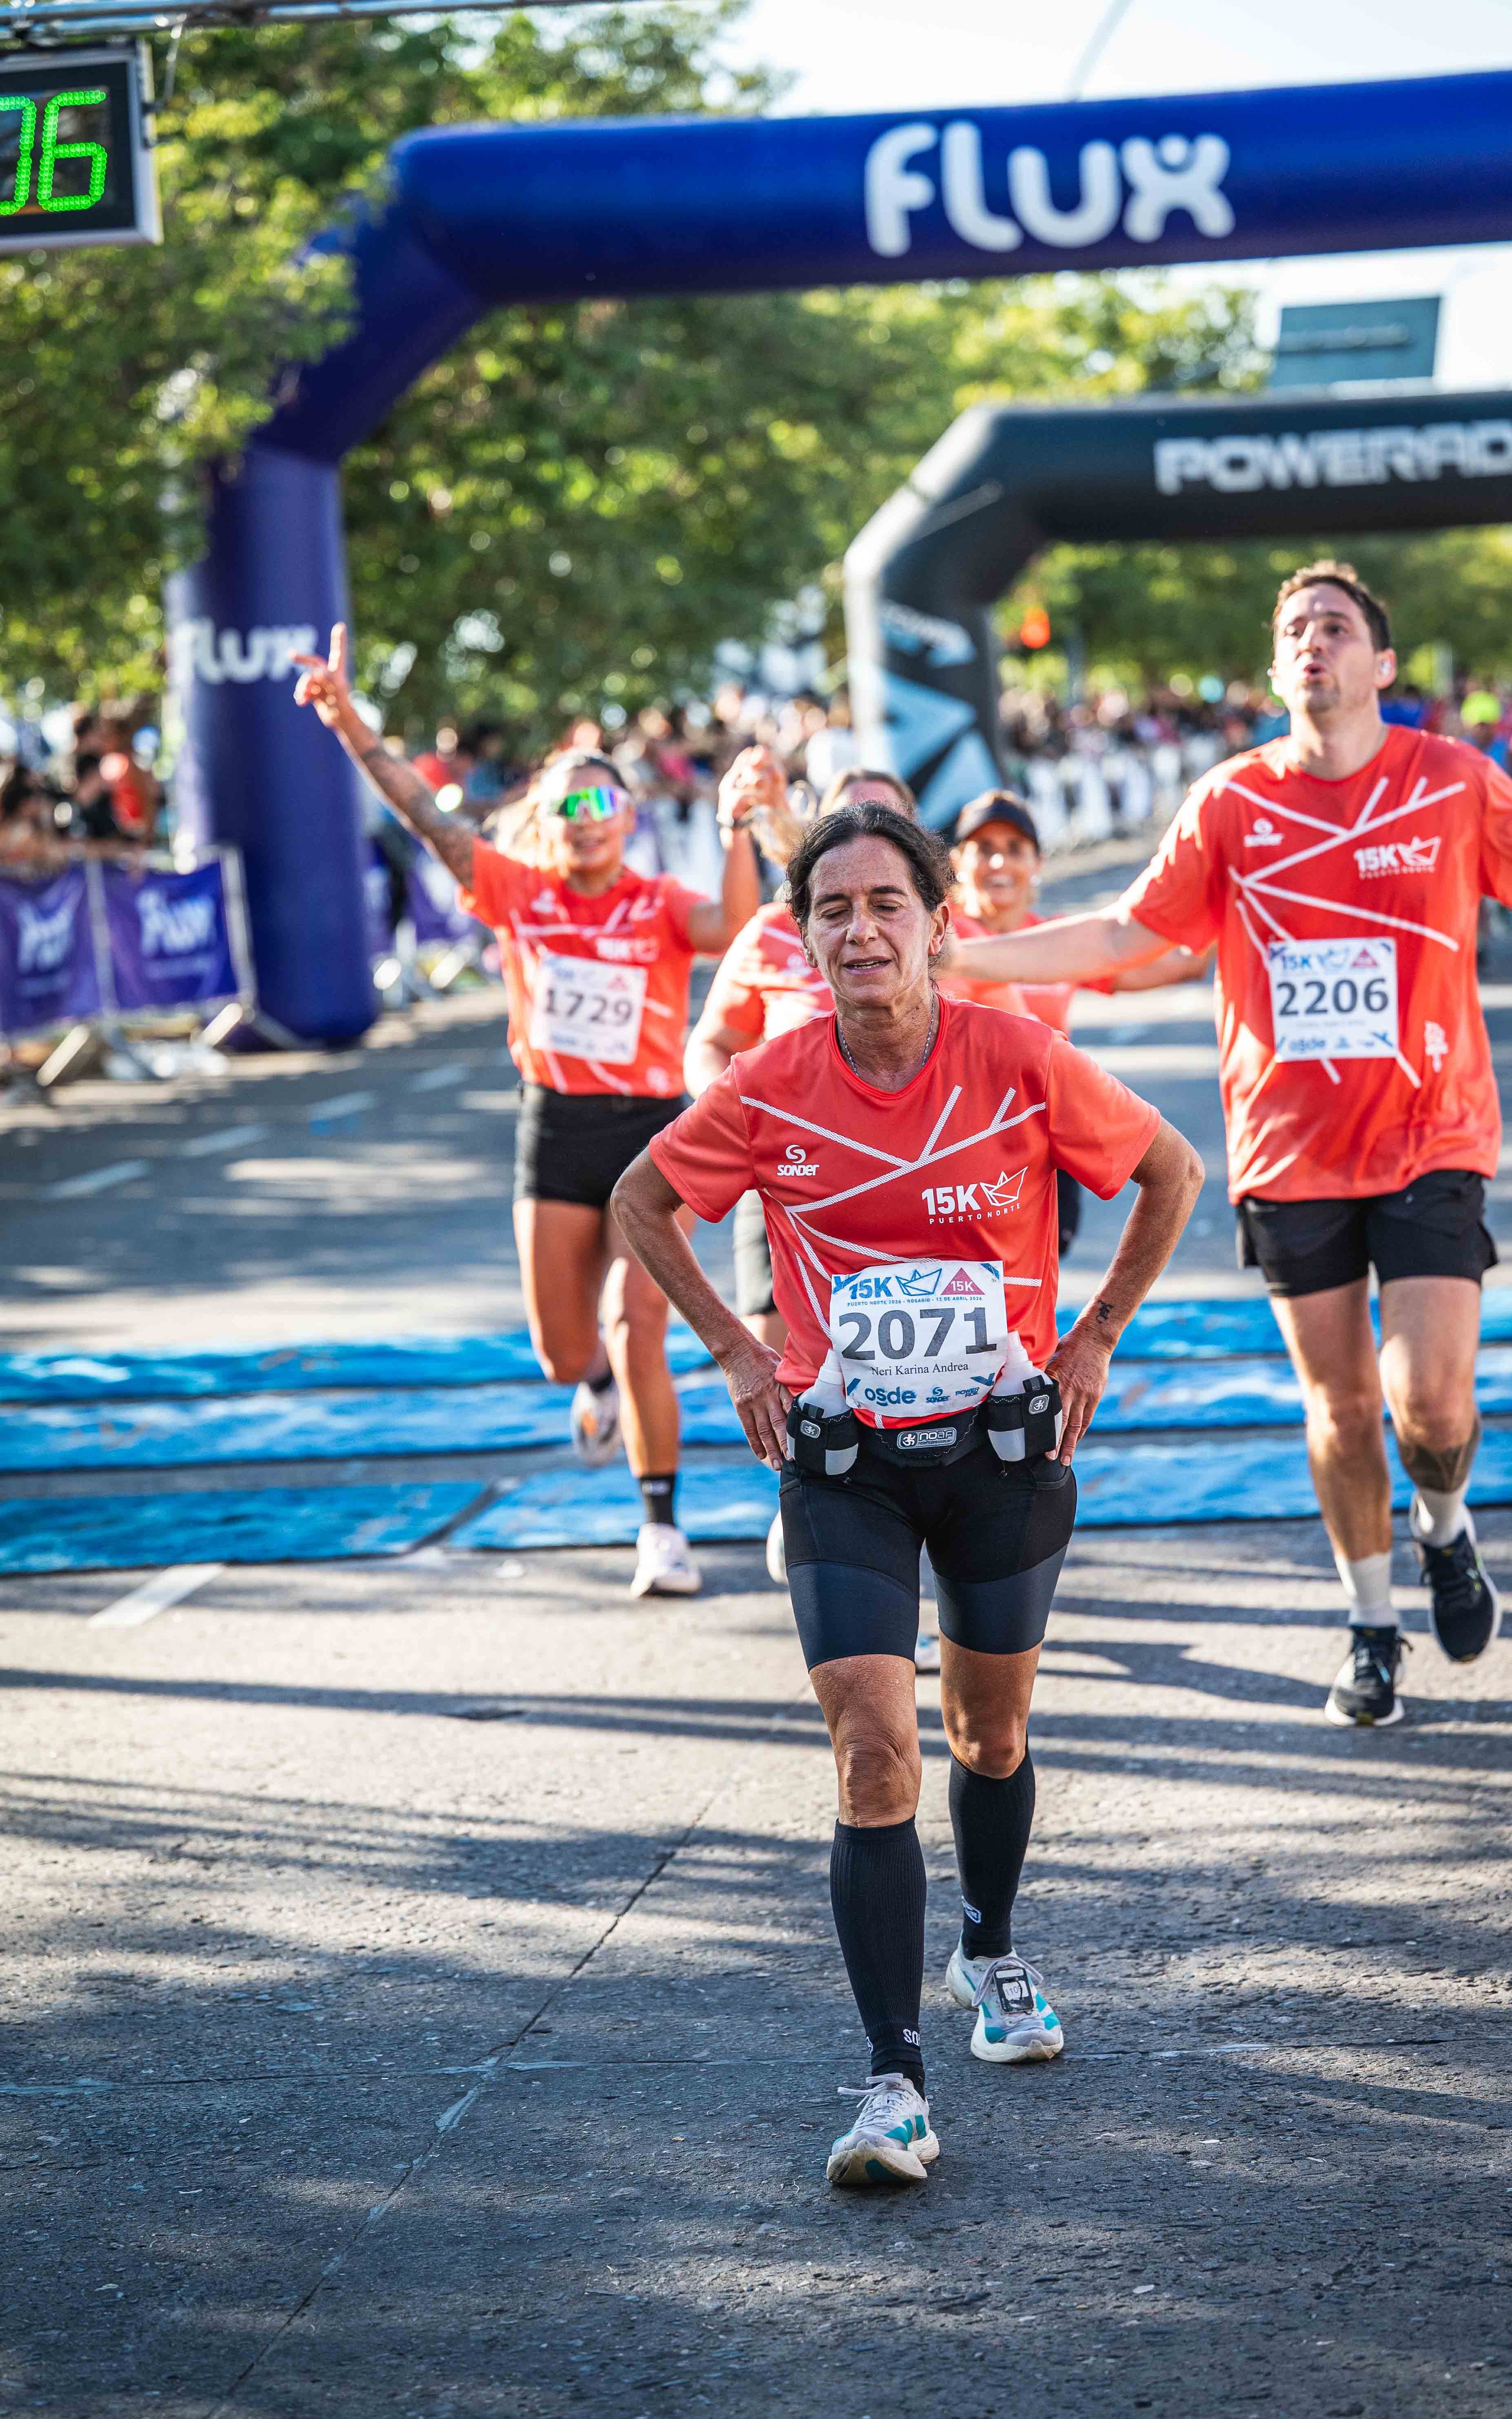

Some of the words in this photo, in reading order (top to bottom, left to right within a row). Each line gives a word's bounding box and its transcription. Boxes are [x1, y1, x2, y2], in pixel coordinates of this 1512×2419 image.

[1277, 977, 1389, 1016] 2206
[546, 987, 633, 1027] 1729
[921, 1183, 979, 1215] 15K
[849, 1277, 893, 1299] 15K
[951, 1281, 974, 1292] 15K
[839, 1307, 997, 1361] 2071
[870, 1366, 892, 1376] Neri
[895, 1364, 929, 1375] Karina
[933, 1362, 969, 1373] Andrea
[864, 1386, 917, 1404] osde
[955, 1387, 980, 1396] POWER
[903, 2028, 920, 2046] SO
